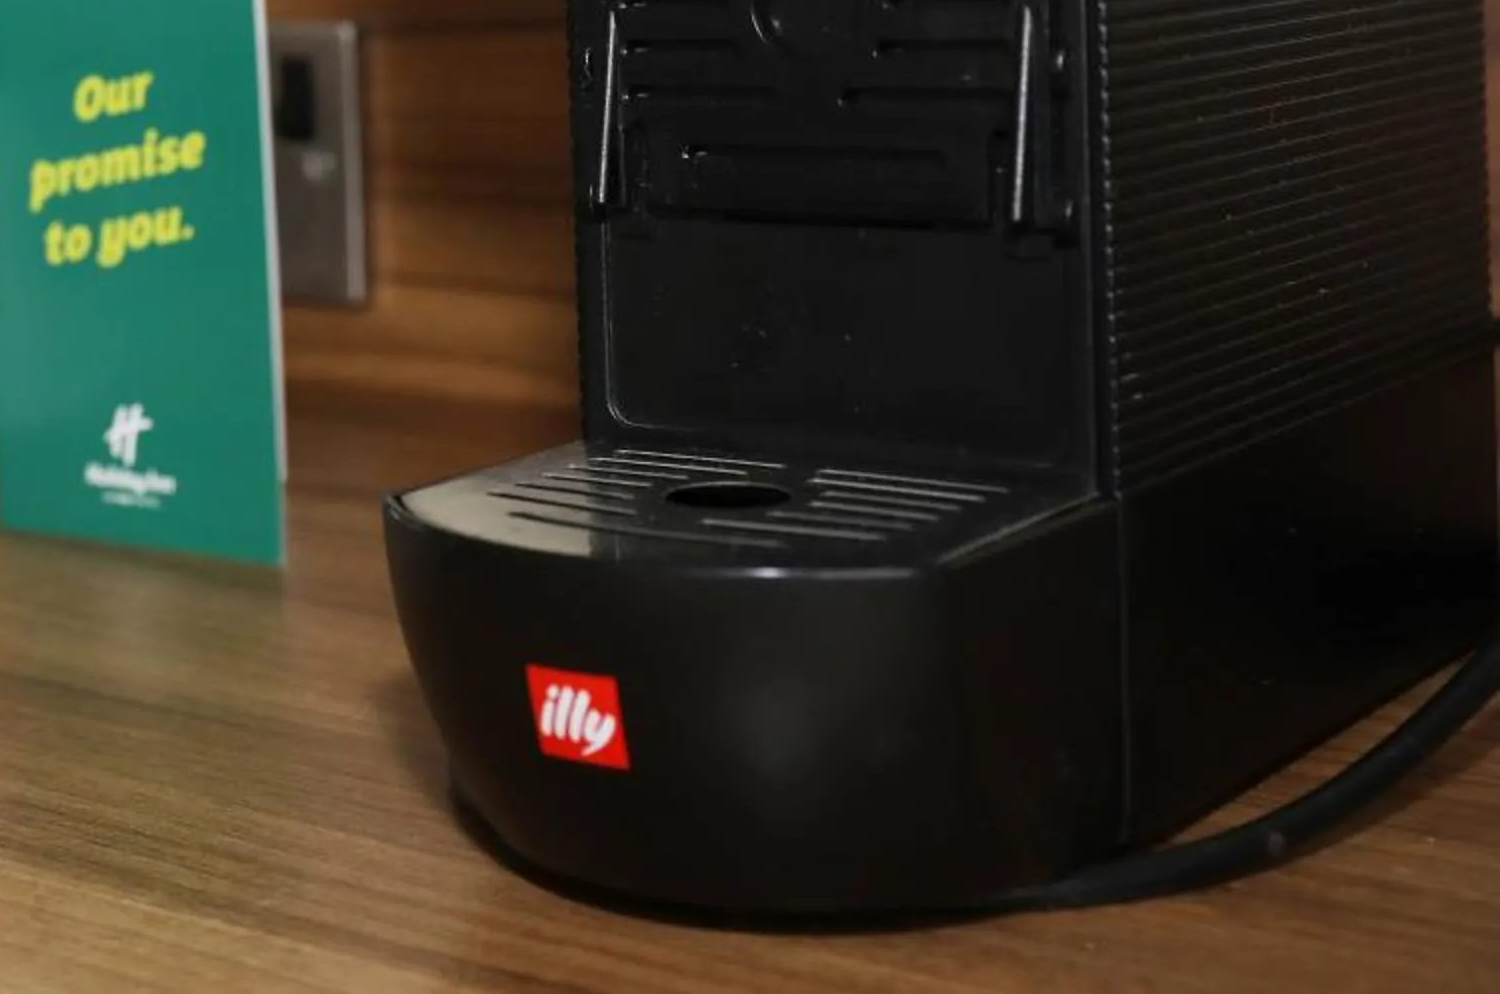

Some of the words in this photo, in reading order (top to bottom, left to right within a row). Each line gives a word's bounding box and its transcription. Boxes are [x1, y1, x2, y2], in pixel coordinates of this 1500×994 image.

[73, 71, 153, 122] Our
[28, 129, 207, 213] promise
[43, 222, 92, 266] to
[97, 206, 195, 268] you.
[541, 683, 616, 757] illy
